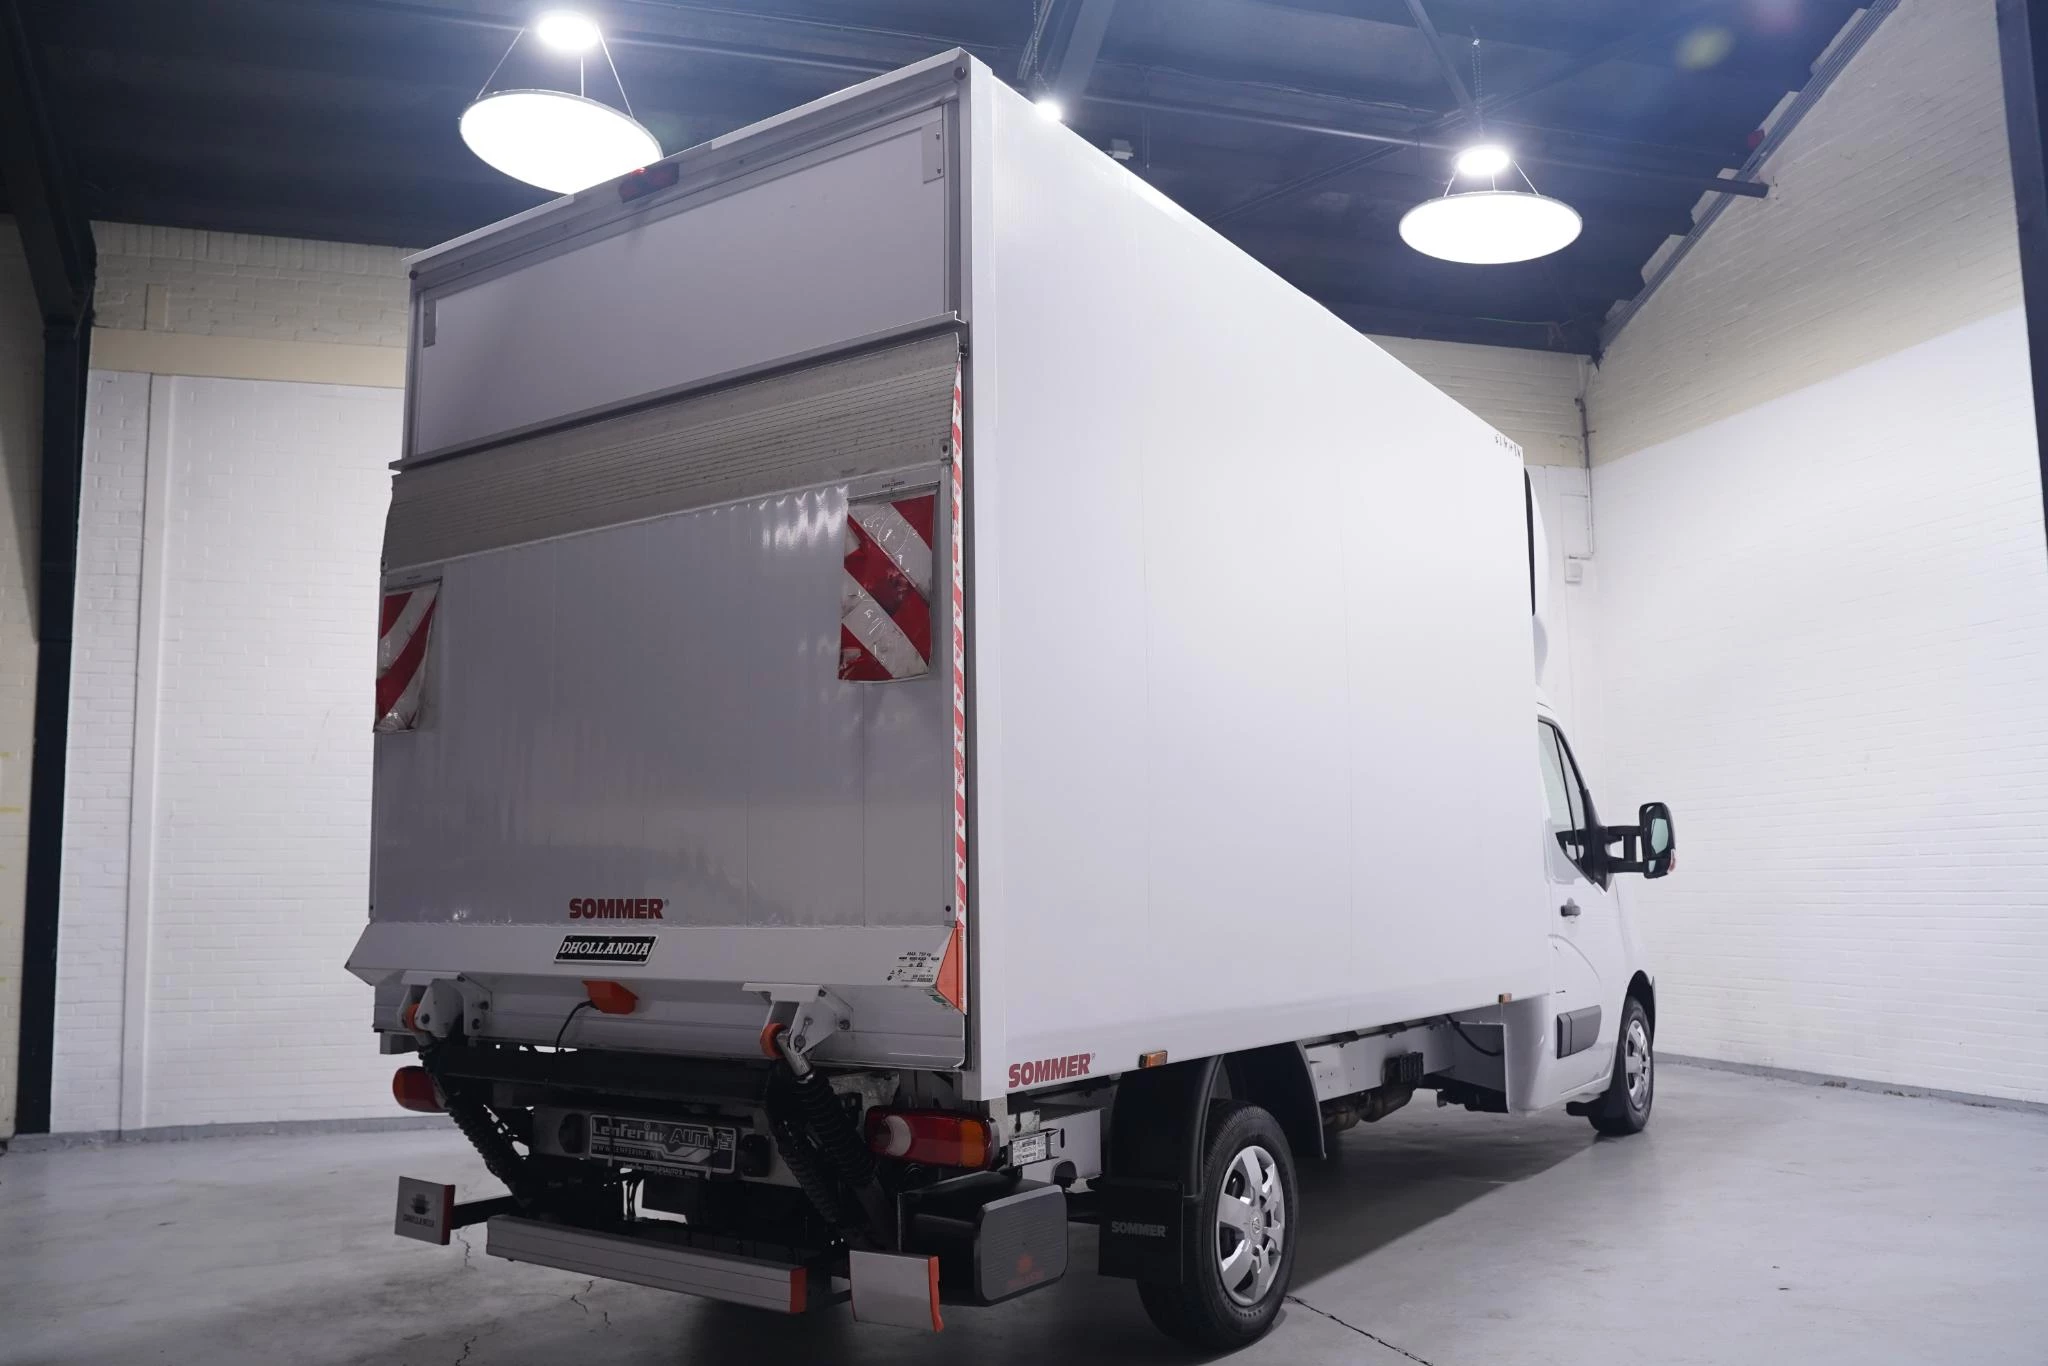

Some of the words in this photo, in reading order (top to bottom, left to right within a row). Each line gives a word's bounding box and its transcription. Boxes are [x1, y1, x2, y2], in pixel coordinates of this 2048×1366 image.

[560, 941, 651, 956] DHOLLANDIA
[1008, 1053, 1091, 1088] SOMMER
[1111, 1220, 1166, 1238] SOMMER
